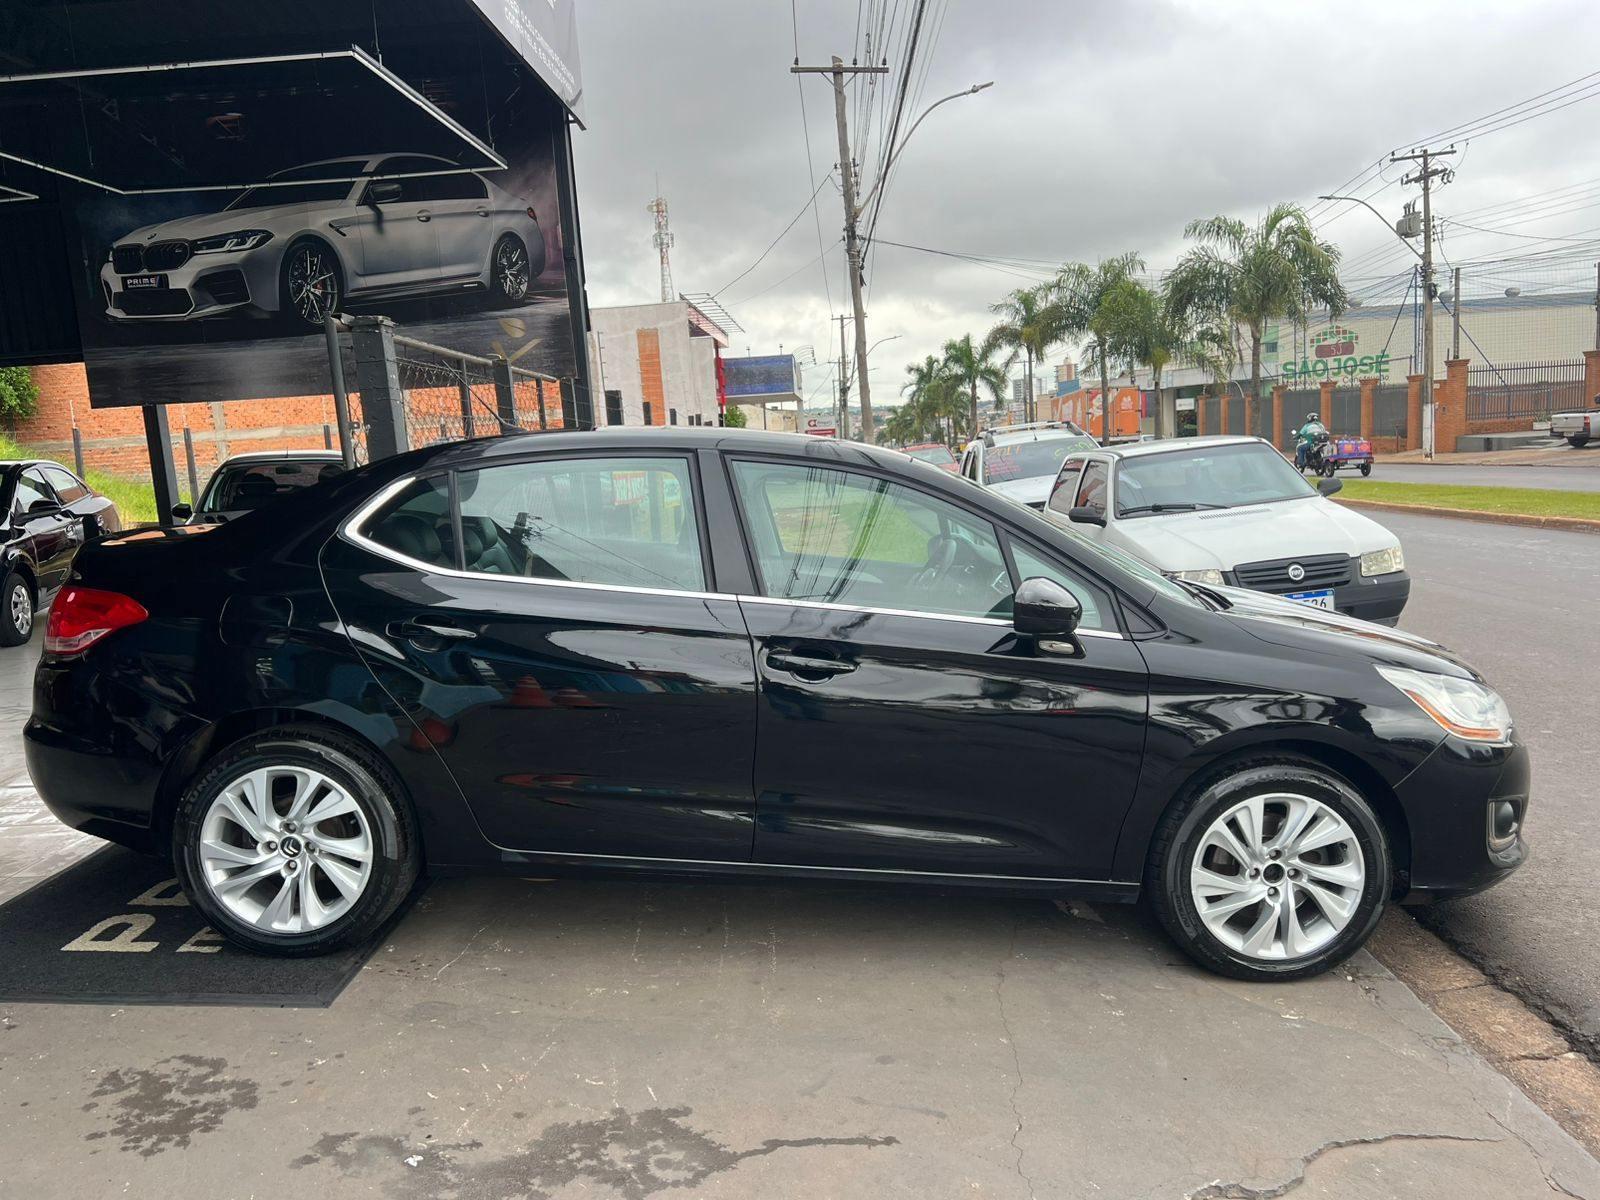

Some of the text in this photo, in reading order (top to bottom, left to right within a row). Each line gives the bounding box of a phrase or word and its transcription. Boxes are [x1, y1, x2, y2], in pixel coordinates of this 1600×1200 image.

[127, 277, 156, 285] PRIME
[1282, 356, 1328, 380] SÃO
[184, 760, 230, 814] SUNNY
